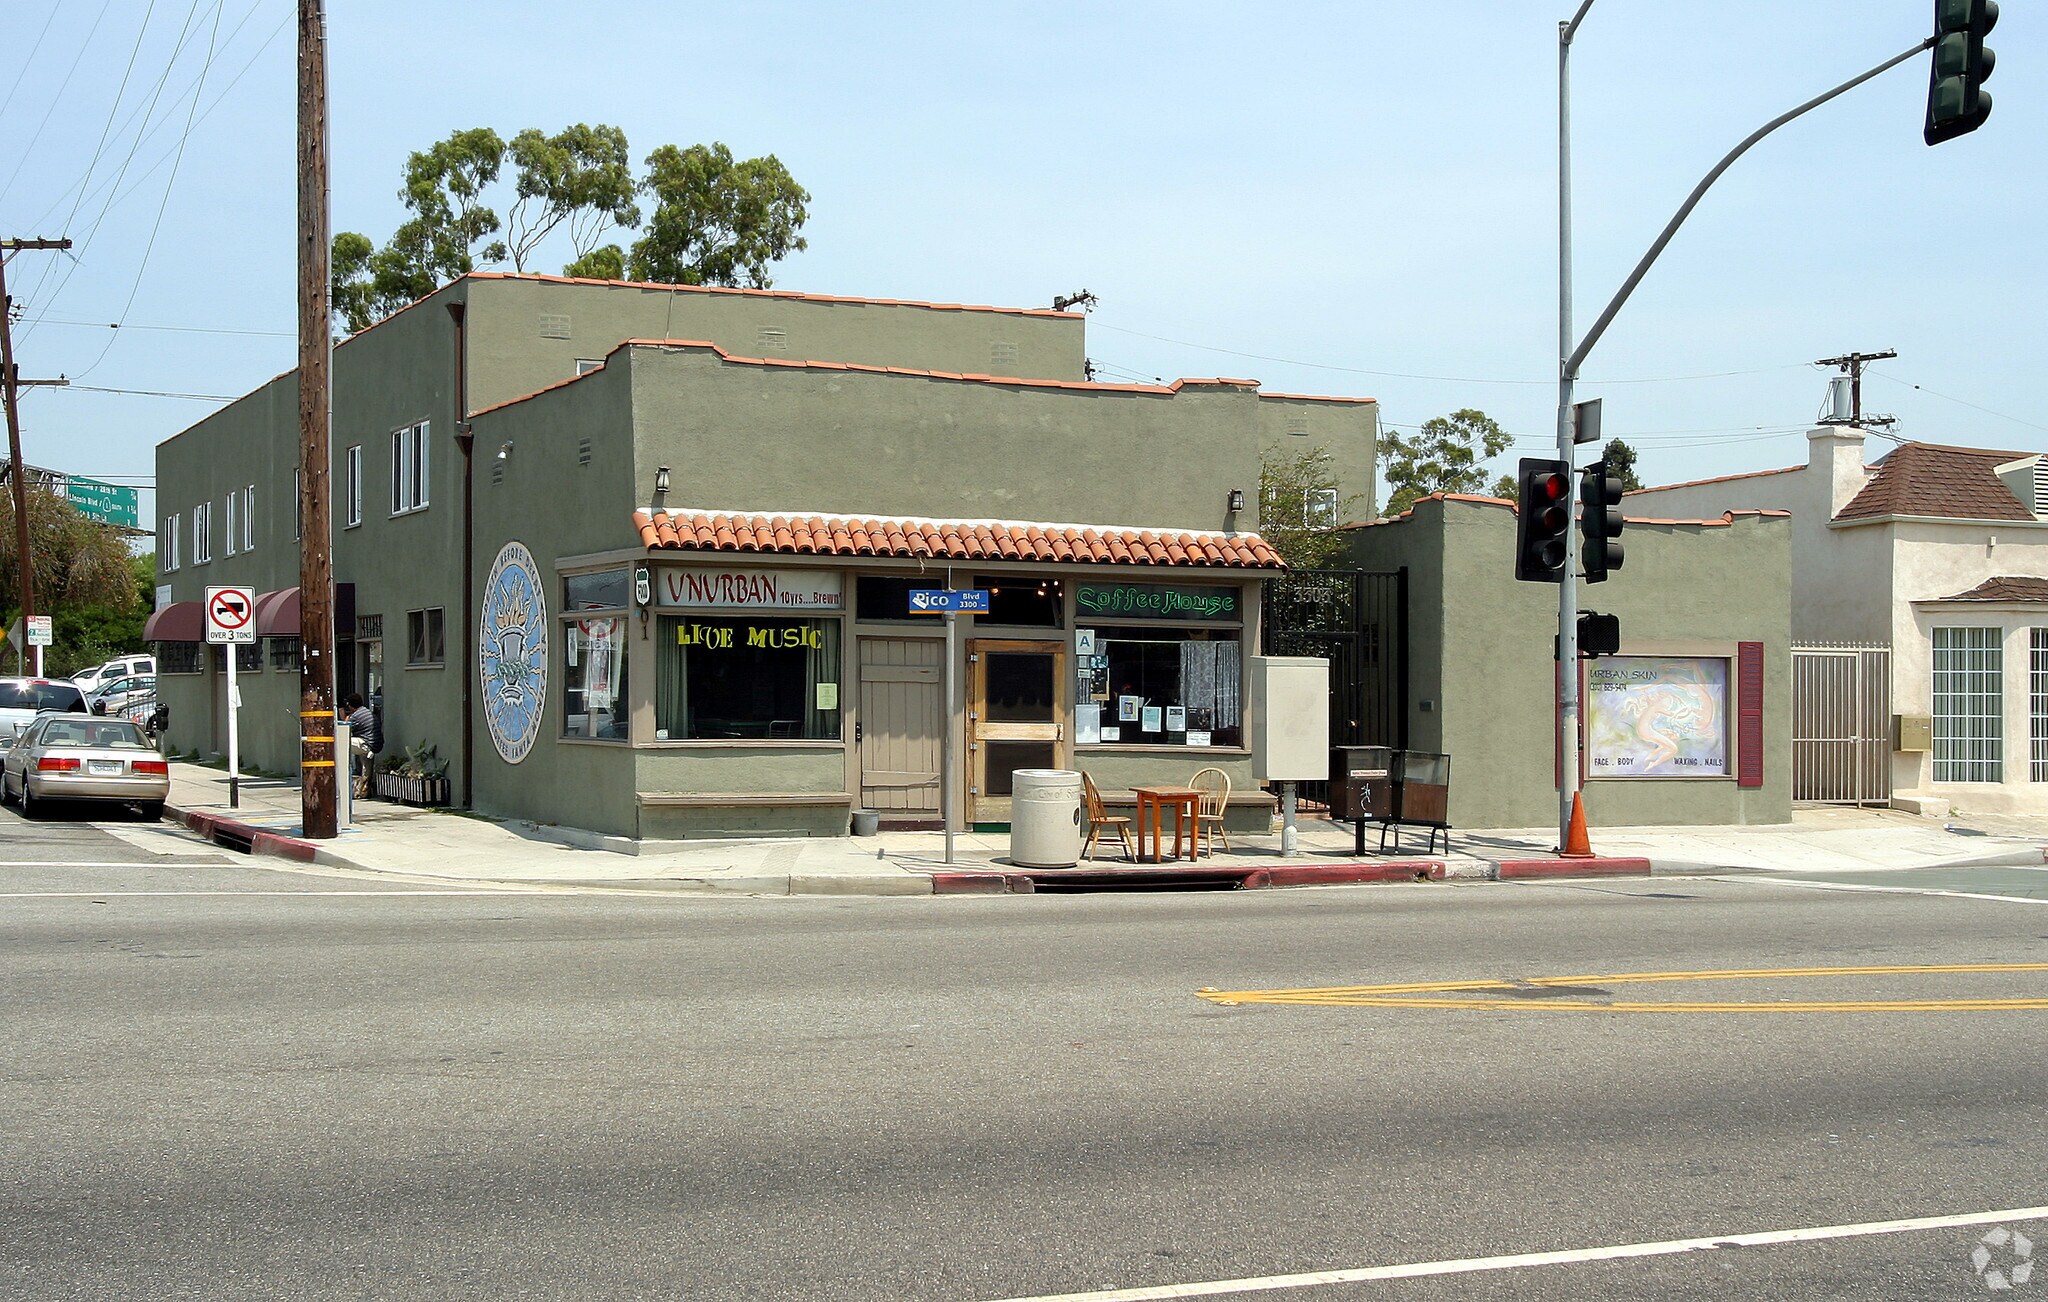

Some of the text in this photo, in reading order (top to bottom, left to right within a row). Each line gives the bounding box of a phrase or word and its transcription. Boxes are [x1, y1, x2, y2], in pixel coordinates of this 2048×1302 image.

[87, 497, 98, 507] Blvd
[668, 573, 777, 603] UNURBAN
[1076, 588, 1234, 616] Coffee House
[228, 630, 234, 640] 3
[677, 624, 823, 650] LIVE MUSIC
[1079, 635, 1090, 647] A
[1590, 669, 1657, 681] URBAN SKIN
[1594, 757, 1634, 766] FACE BODY
[1704, 758, 1723, 767] NAILS
